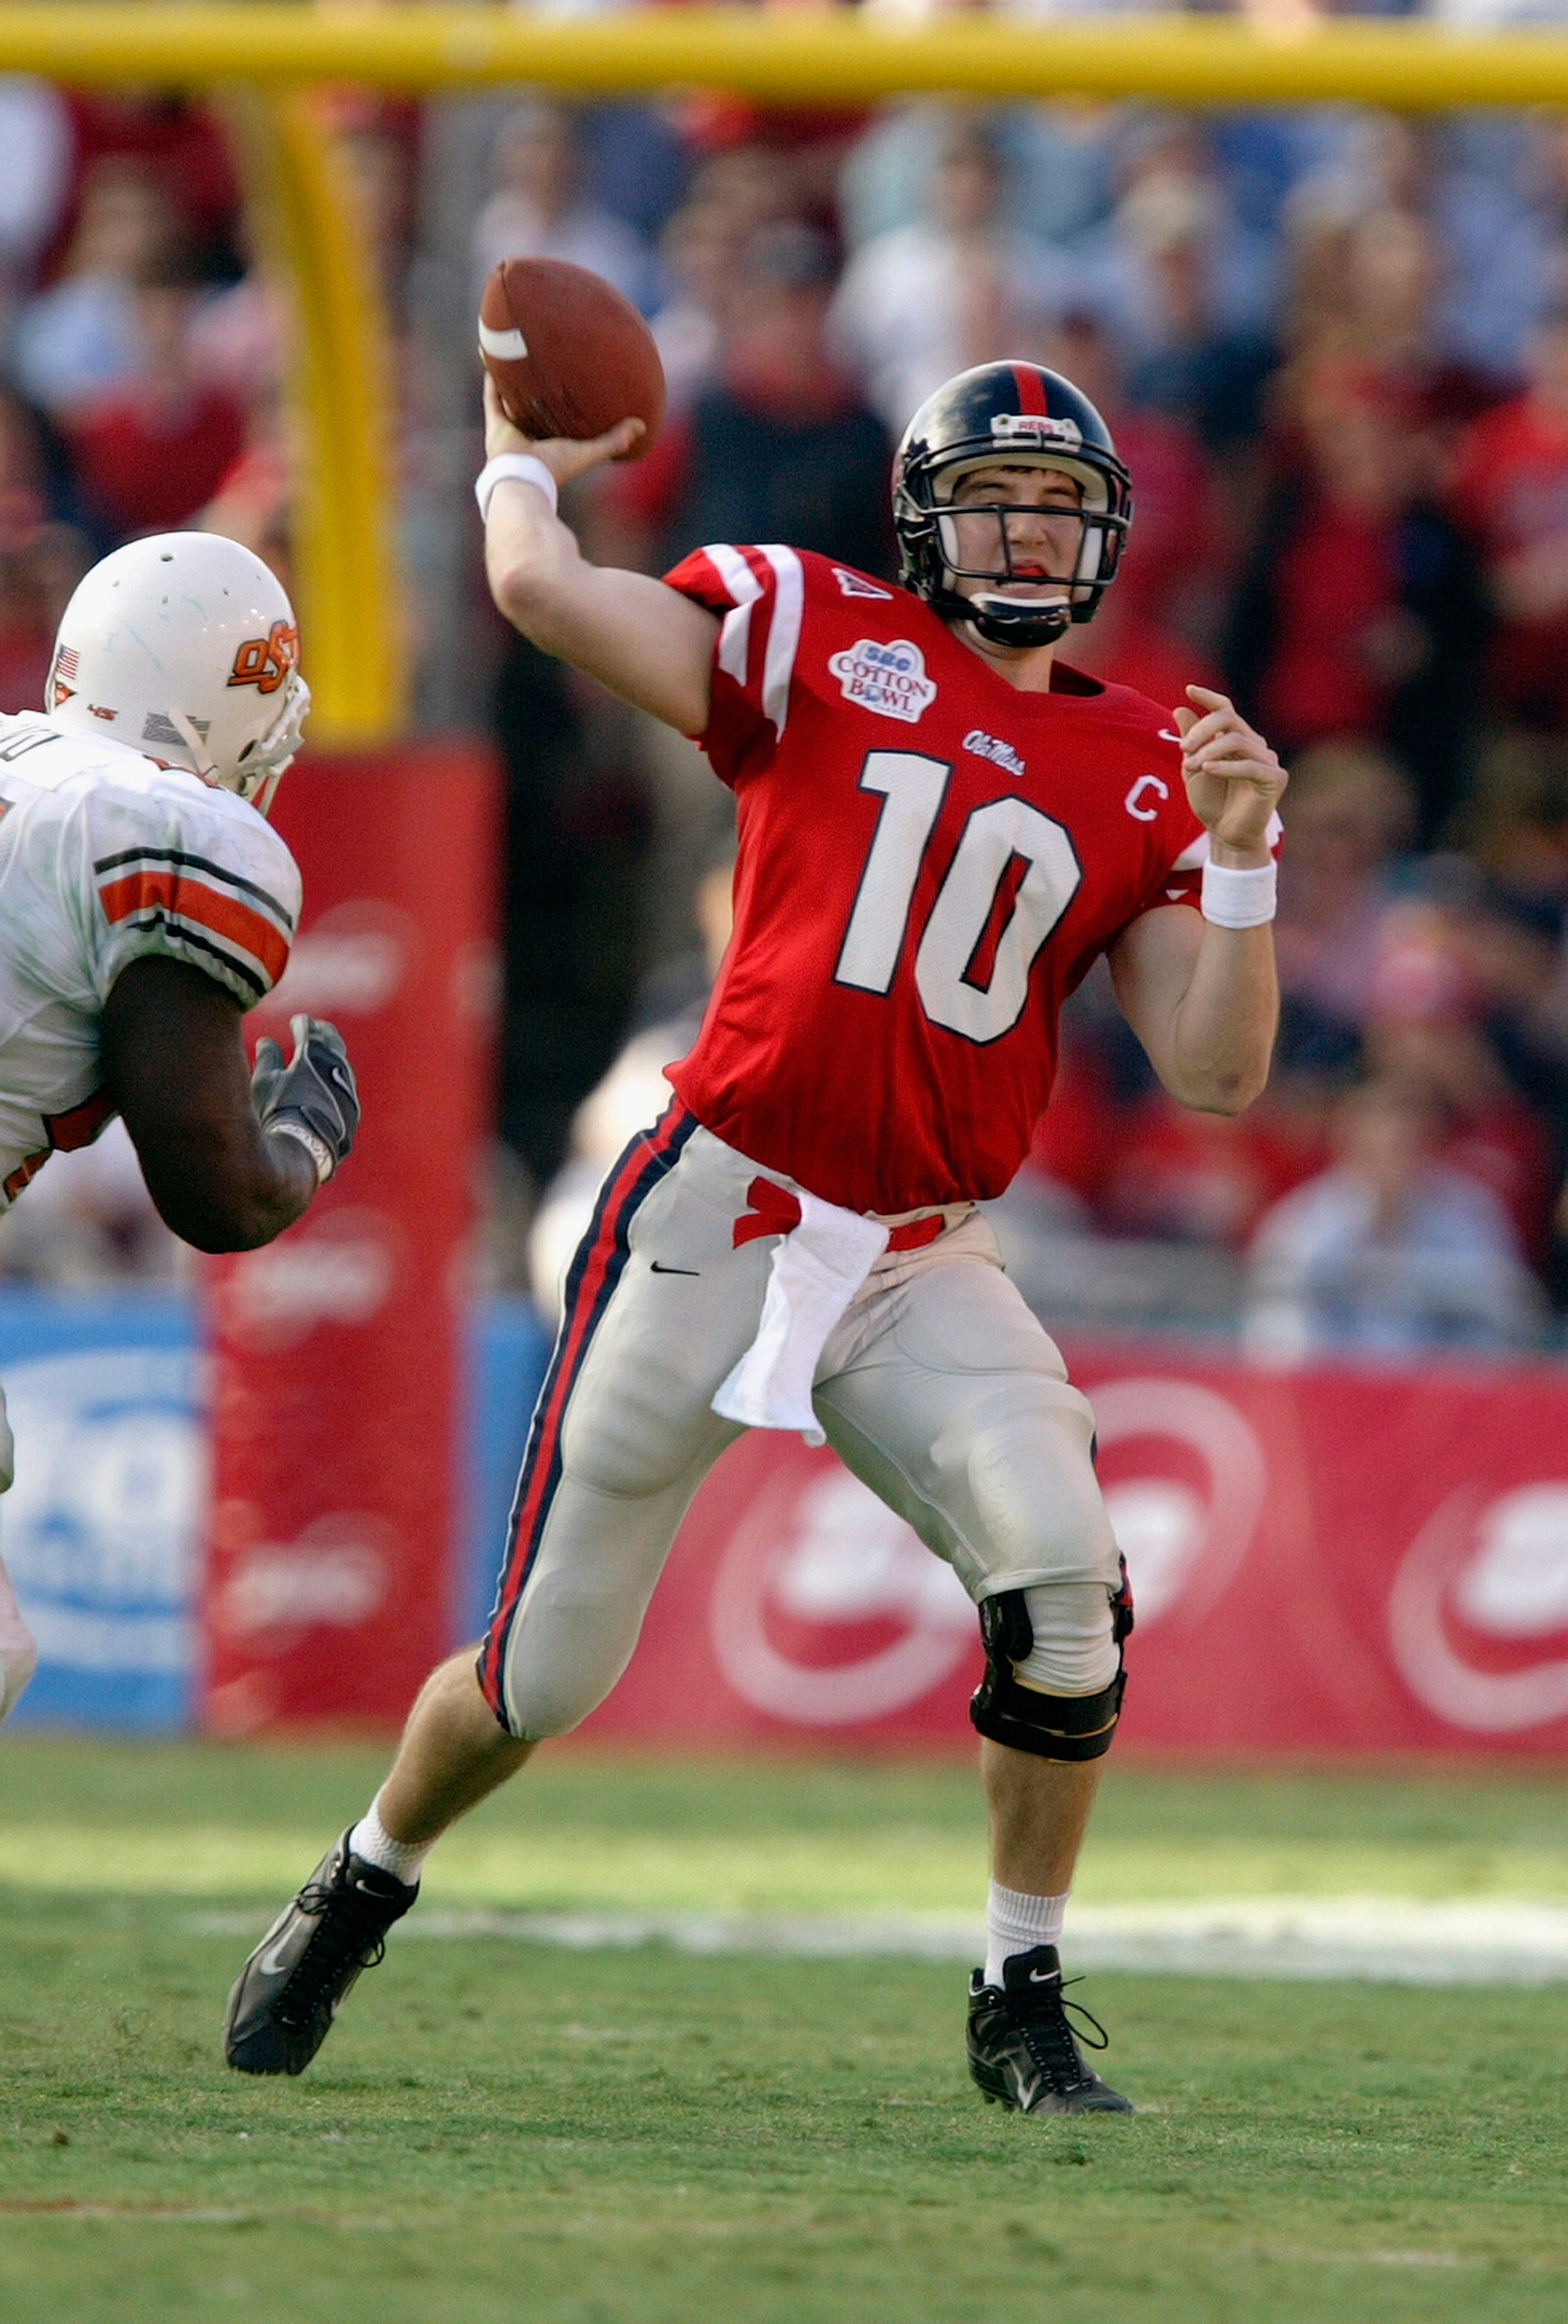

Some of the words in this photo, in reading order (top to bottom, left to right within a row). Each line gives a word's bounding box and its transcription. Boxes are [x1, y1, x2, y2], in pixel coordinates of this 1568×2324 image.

[838, 656, 929, 698] COTTON
[865, 646, 910, 671] SBC
[849, 678, 913, 712] BOWL
[1125, 775, 1169, 821] C
[832, 748, 1085, 1047] 10
